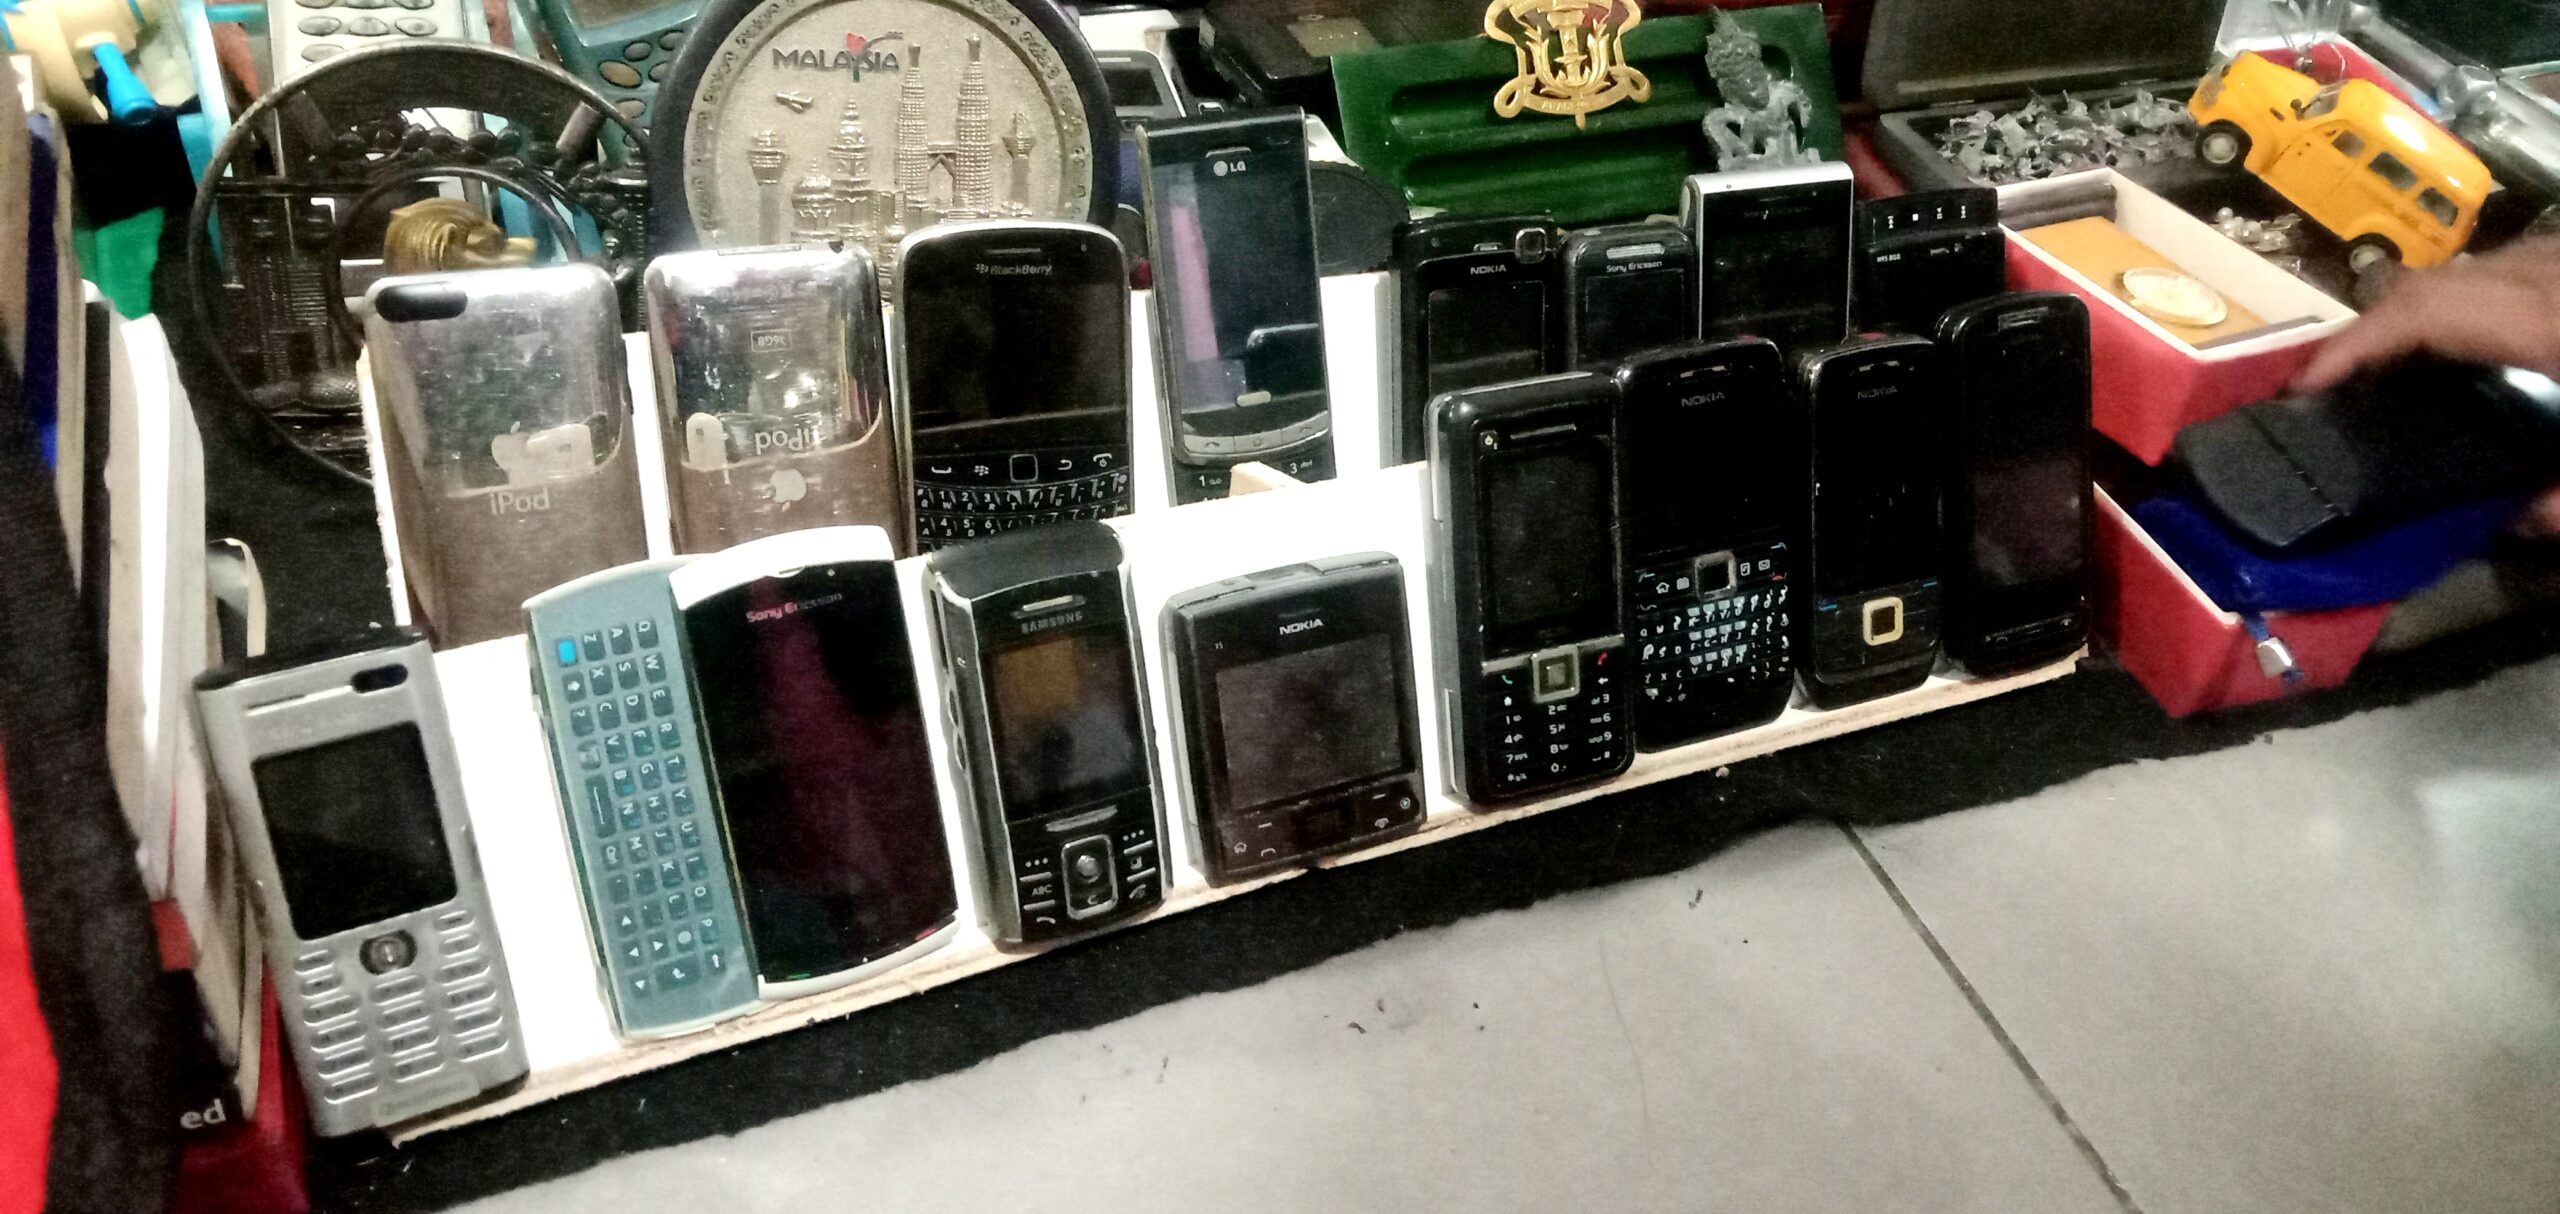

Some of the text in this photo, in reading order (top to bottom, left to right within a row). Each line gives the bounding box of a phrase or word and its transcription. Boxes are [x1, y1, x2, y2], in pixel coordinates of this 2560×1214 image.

[772, 48, 899, 72] MALAYSIA
[1230, 160, 1246, 172] LG
[1470, 264, 1507, 275] NOKIA
[1682, 391, 1725, 407] NOKIA
[489, 486, 551, 515] iPod
[745, 607, 783, 622] Sony
[1021, 611, 1083, 634] SAMSUNG
[1279, 618, 1324, 635] NOKIA
[180, 1098, 227, 1129] ed
